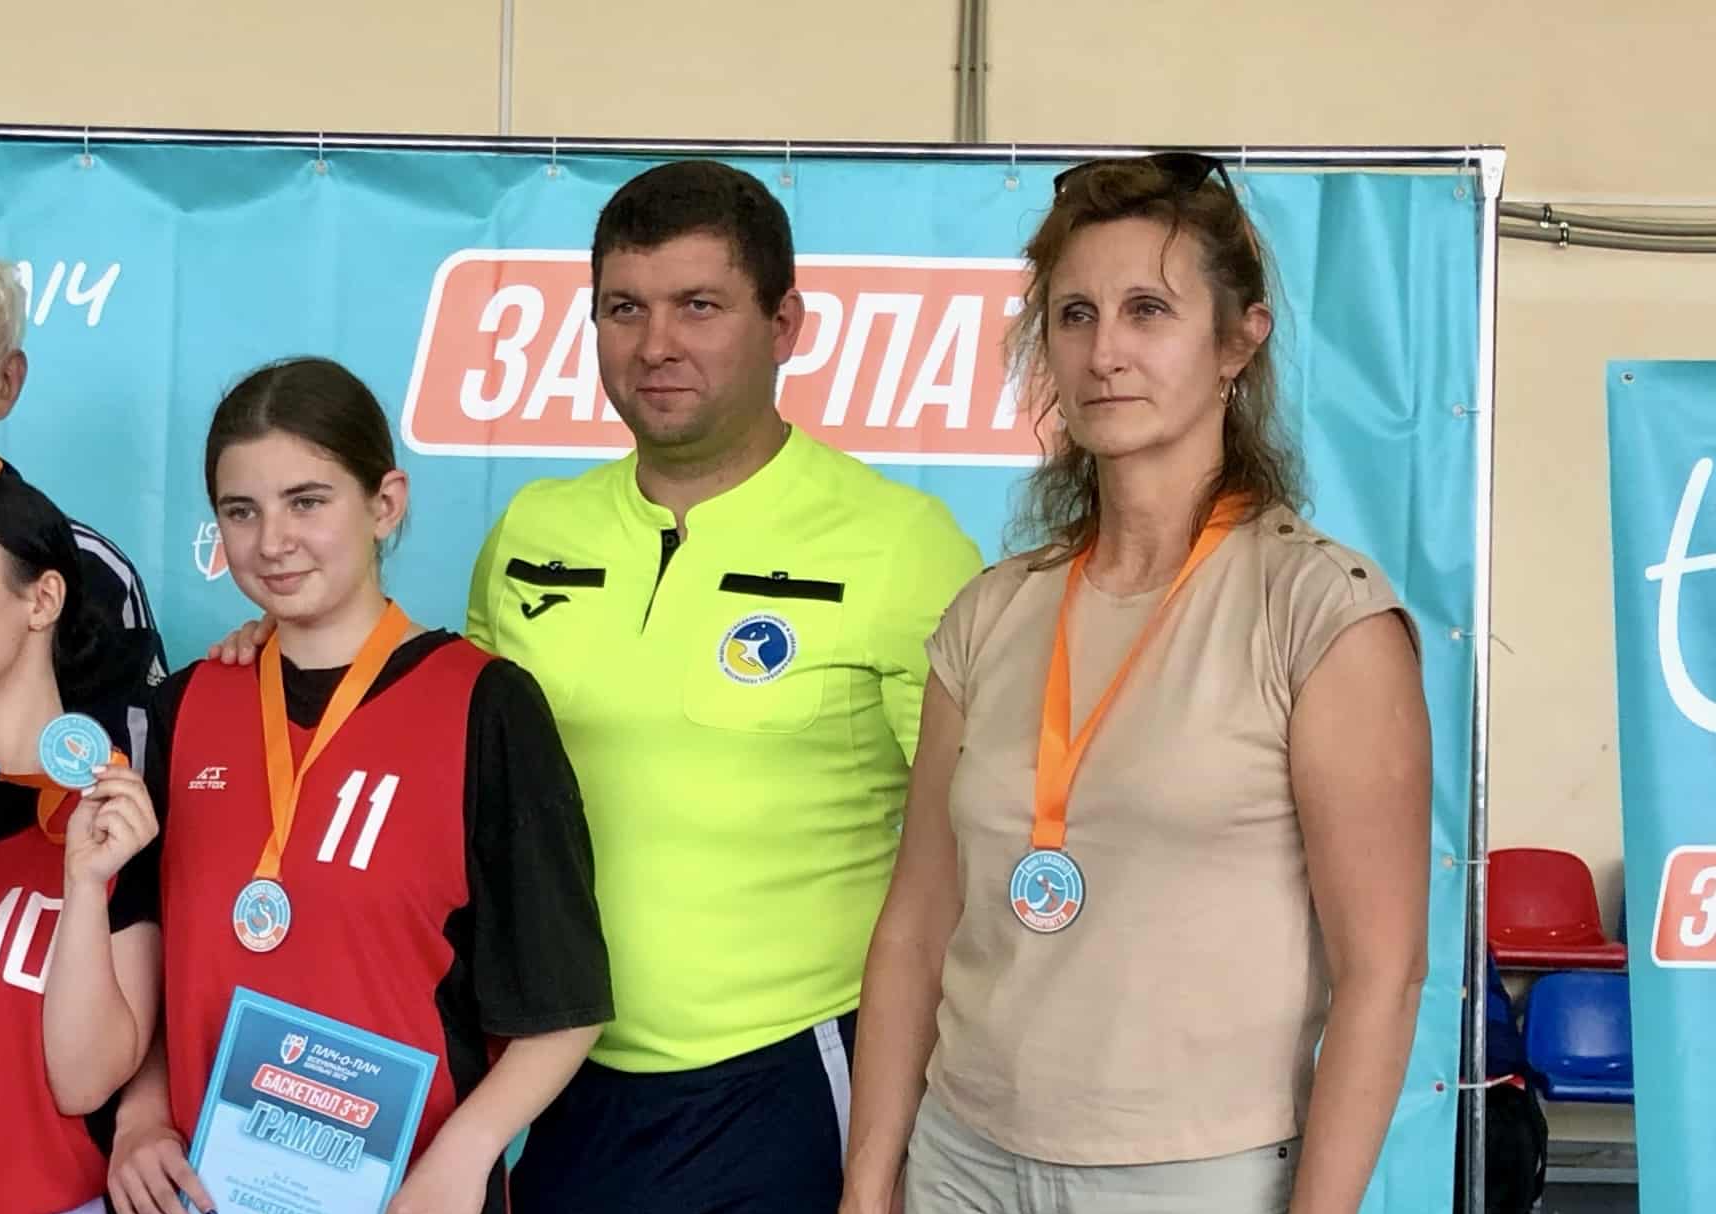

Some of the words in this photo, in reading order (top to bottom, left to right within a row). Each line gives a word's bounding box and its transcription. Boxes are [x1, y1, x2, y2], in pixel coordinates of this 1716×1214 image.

[316, 769, 400, 871] 11
[260, 1070, 342, 1113] БАСКЕТБОЛ
[244, 1099, 366, 1173] ГРАМОТА
